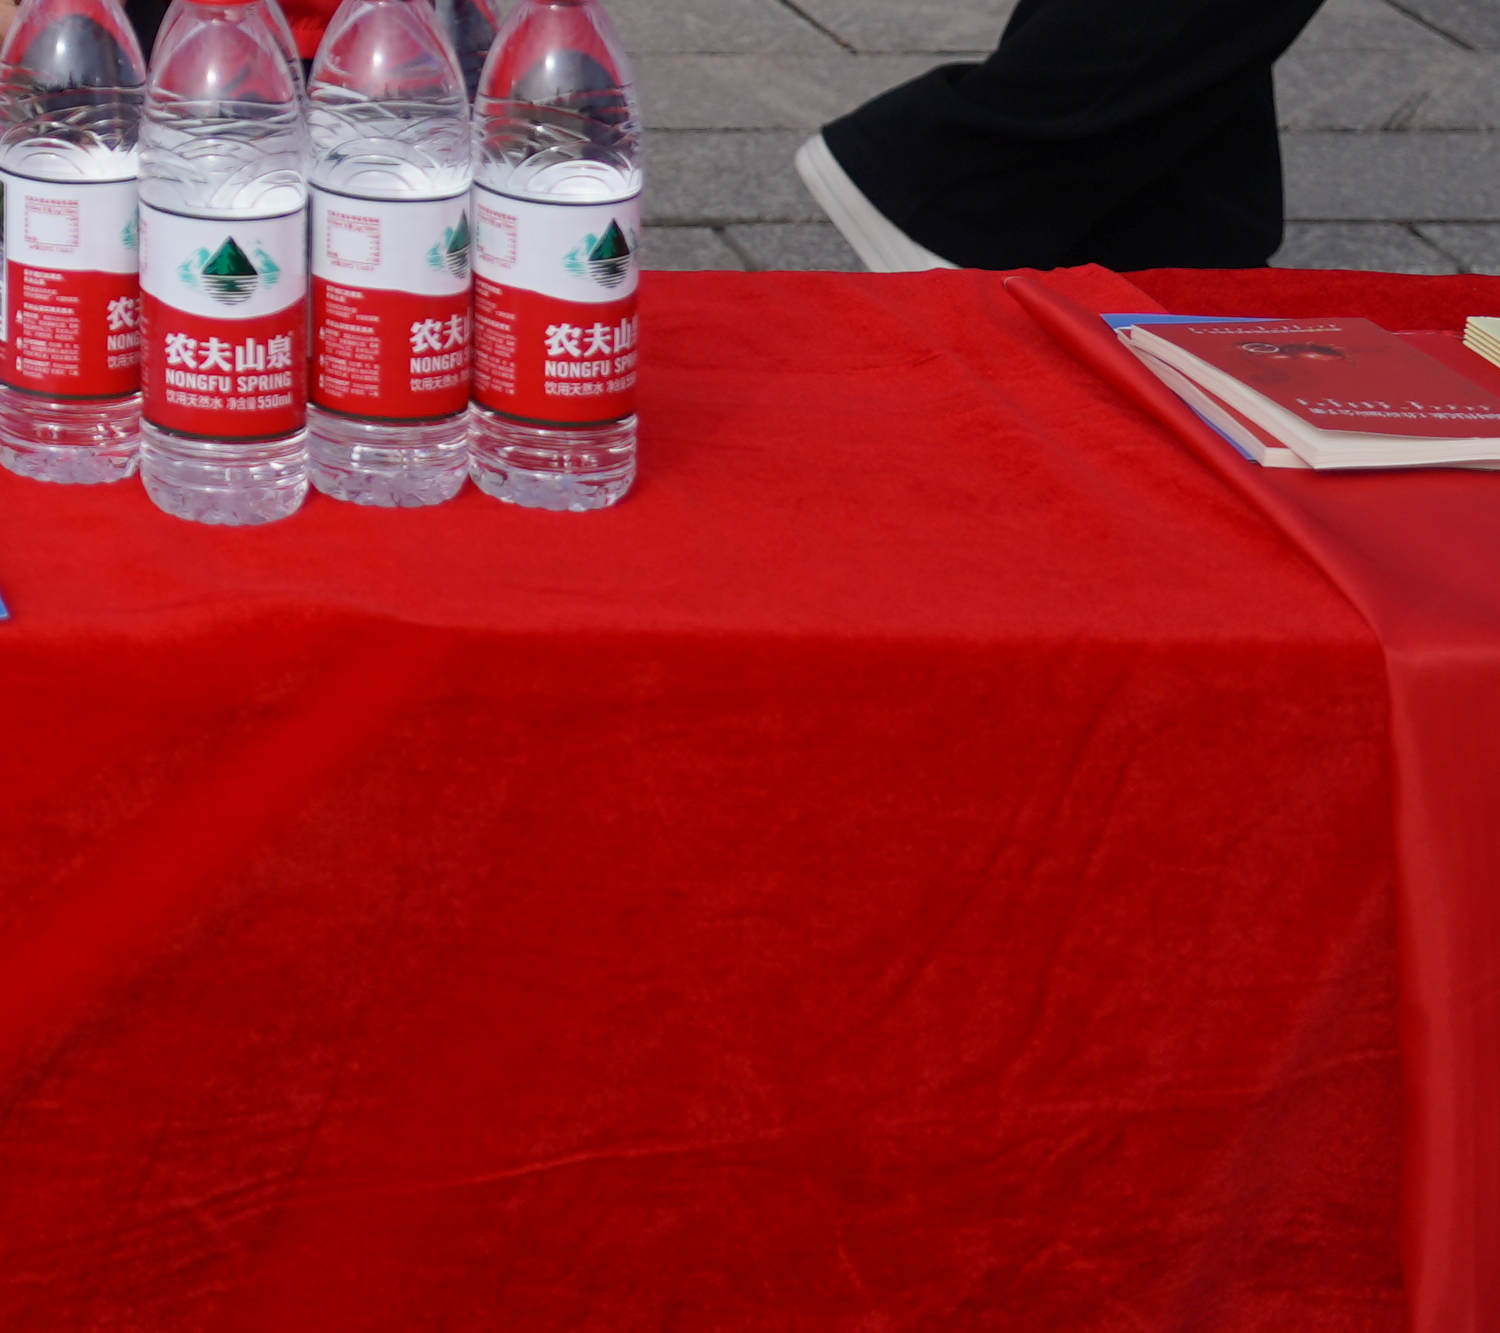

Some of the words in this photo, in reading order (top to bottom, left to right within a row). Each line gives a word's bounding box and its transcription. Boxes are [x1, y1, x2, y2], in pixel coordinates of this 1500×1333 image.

[164, 332, 293, 371] 农夫山泉
[409, 349, 463, 374] NONGFU
[544, 360, 610, 378] NONGFU
[165, 368, 231, 392] NONGFU
[236, 371, 293, 393] SPRING
[544, 380, 604, 396] 饮用天然水
[166, 389, 223, 409] 饮用天然水
